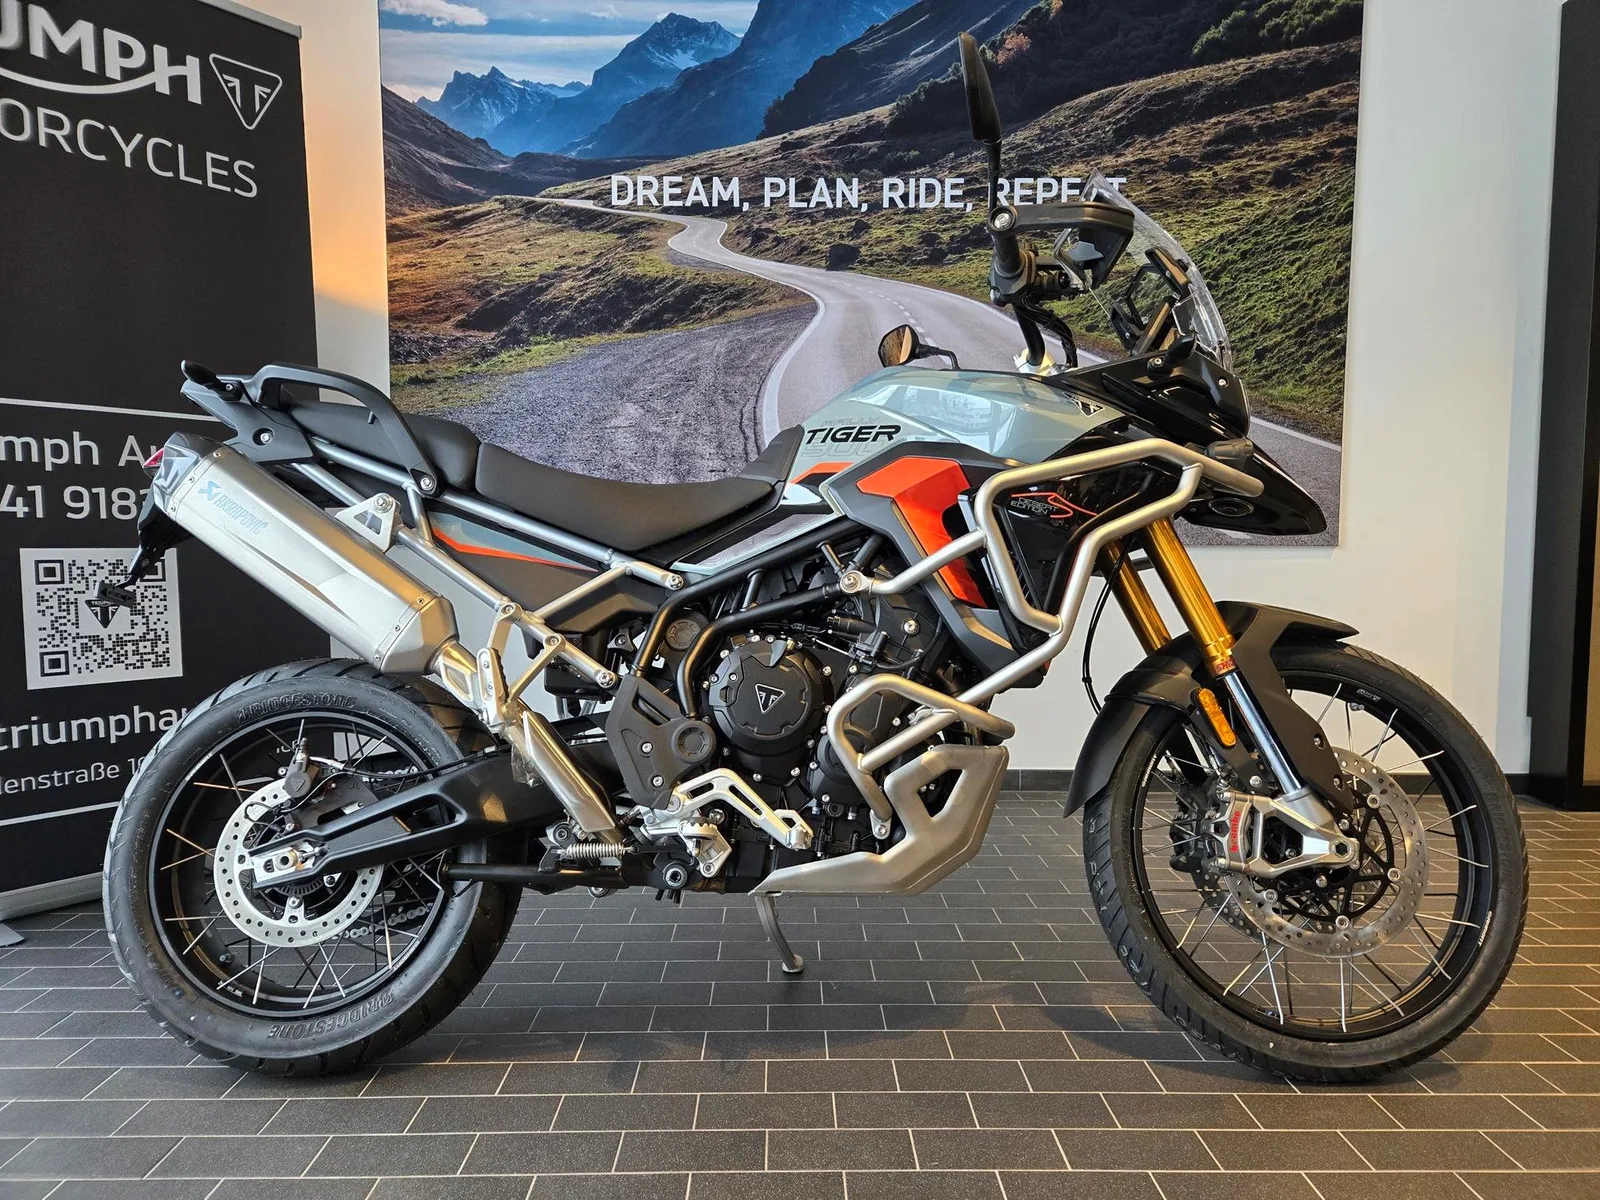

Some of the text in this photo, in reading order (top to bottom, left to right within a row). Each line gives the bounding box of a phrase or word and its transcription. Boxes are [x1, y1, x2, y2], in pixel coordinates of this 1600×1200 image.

[0, 97, 258, 198] ORCYCLES
[610, 174, 750, 212] DREAM,
[764, 177, 869, 212] PLAN,
[882, 177, 973, 213] RIDE,
[0, 431, 157, 472] mph A
[806, 424, 902, 445] TIGER
[0, 484, 44, 518] 41
[0, 762, 120, 796] enstraße
